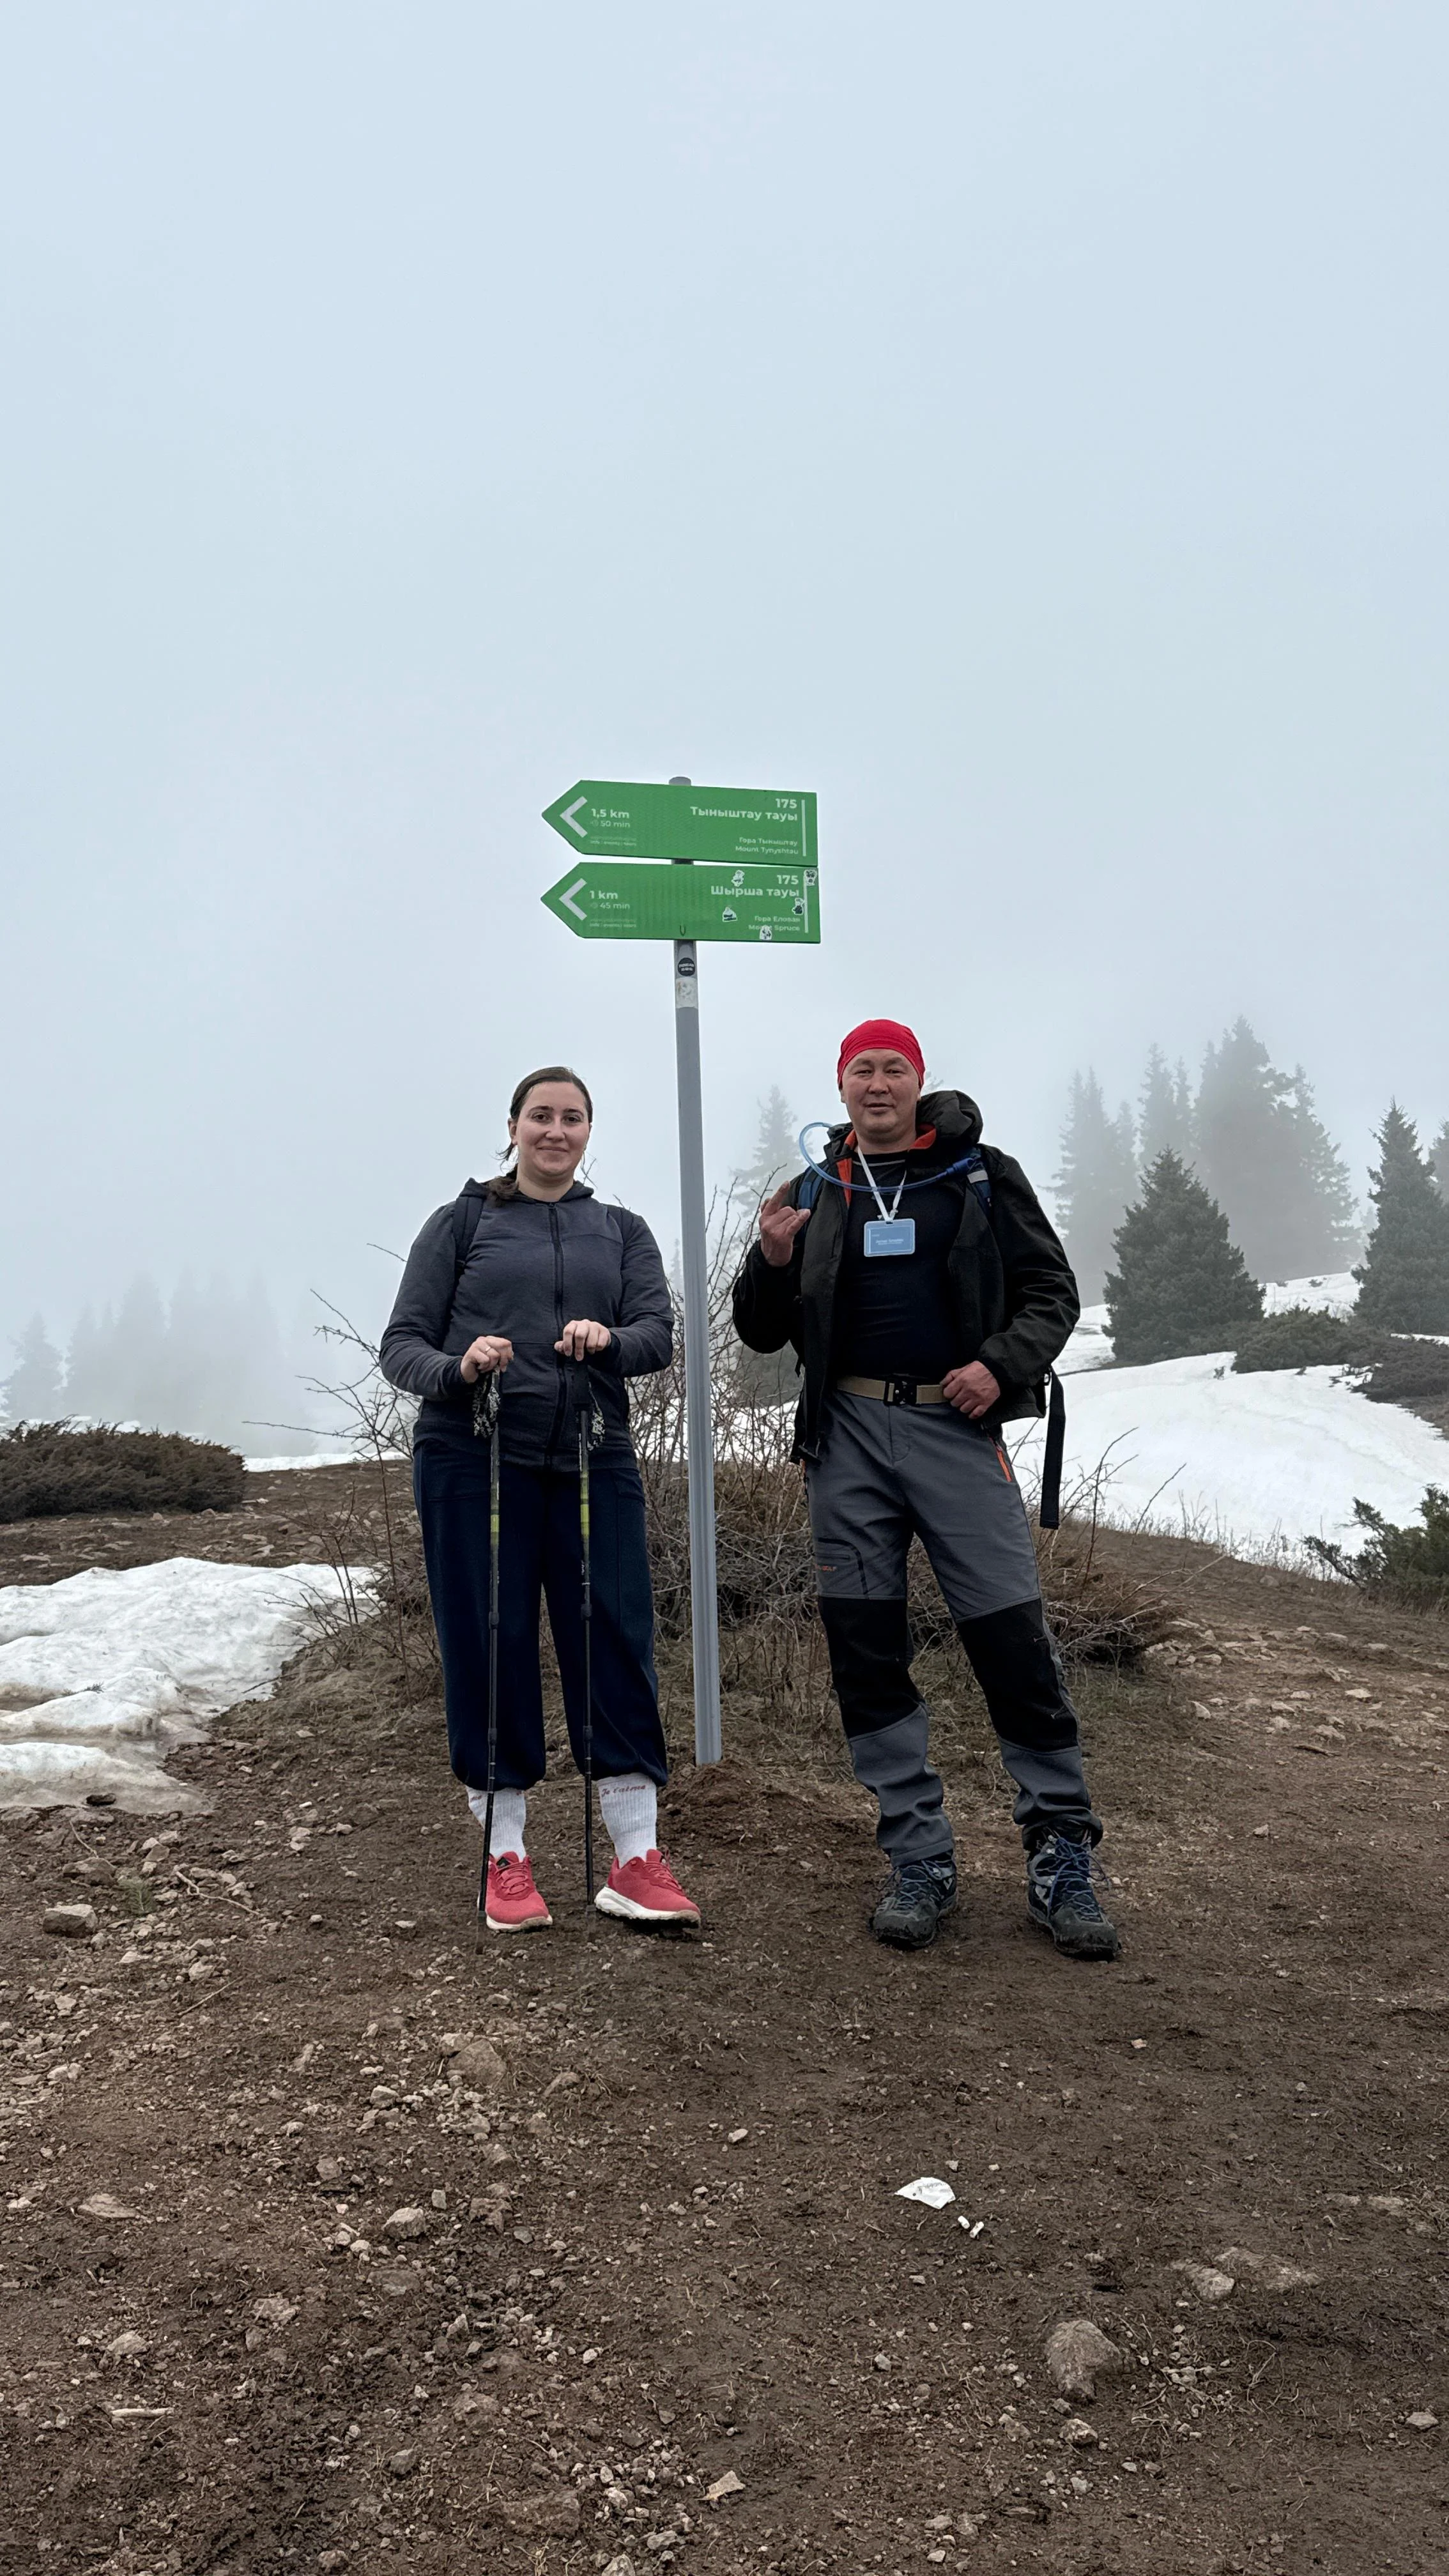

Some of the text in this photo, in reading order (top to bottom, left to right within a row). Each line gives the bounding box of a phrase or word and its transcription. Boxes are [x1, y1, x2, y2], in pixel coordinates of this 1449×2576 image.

[775, 798, 798, 809] 175
[591, 808, 630, 818] 1,5 km
[690, 806, 798, 822] Тыныштау тауы
[777, 875, 799, 885] 175
[590, 890, 618, 900] 1 km
[710, 885, 799, 899] Шырша тауы
